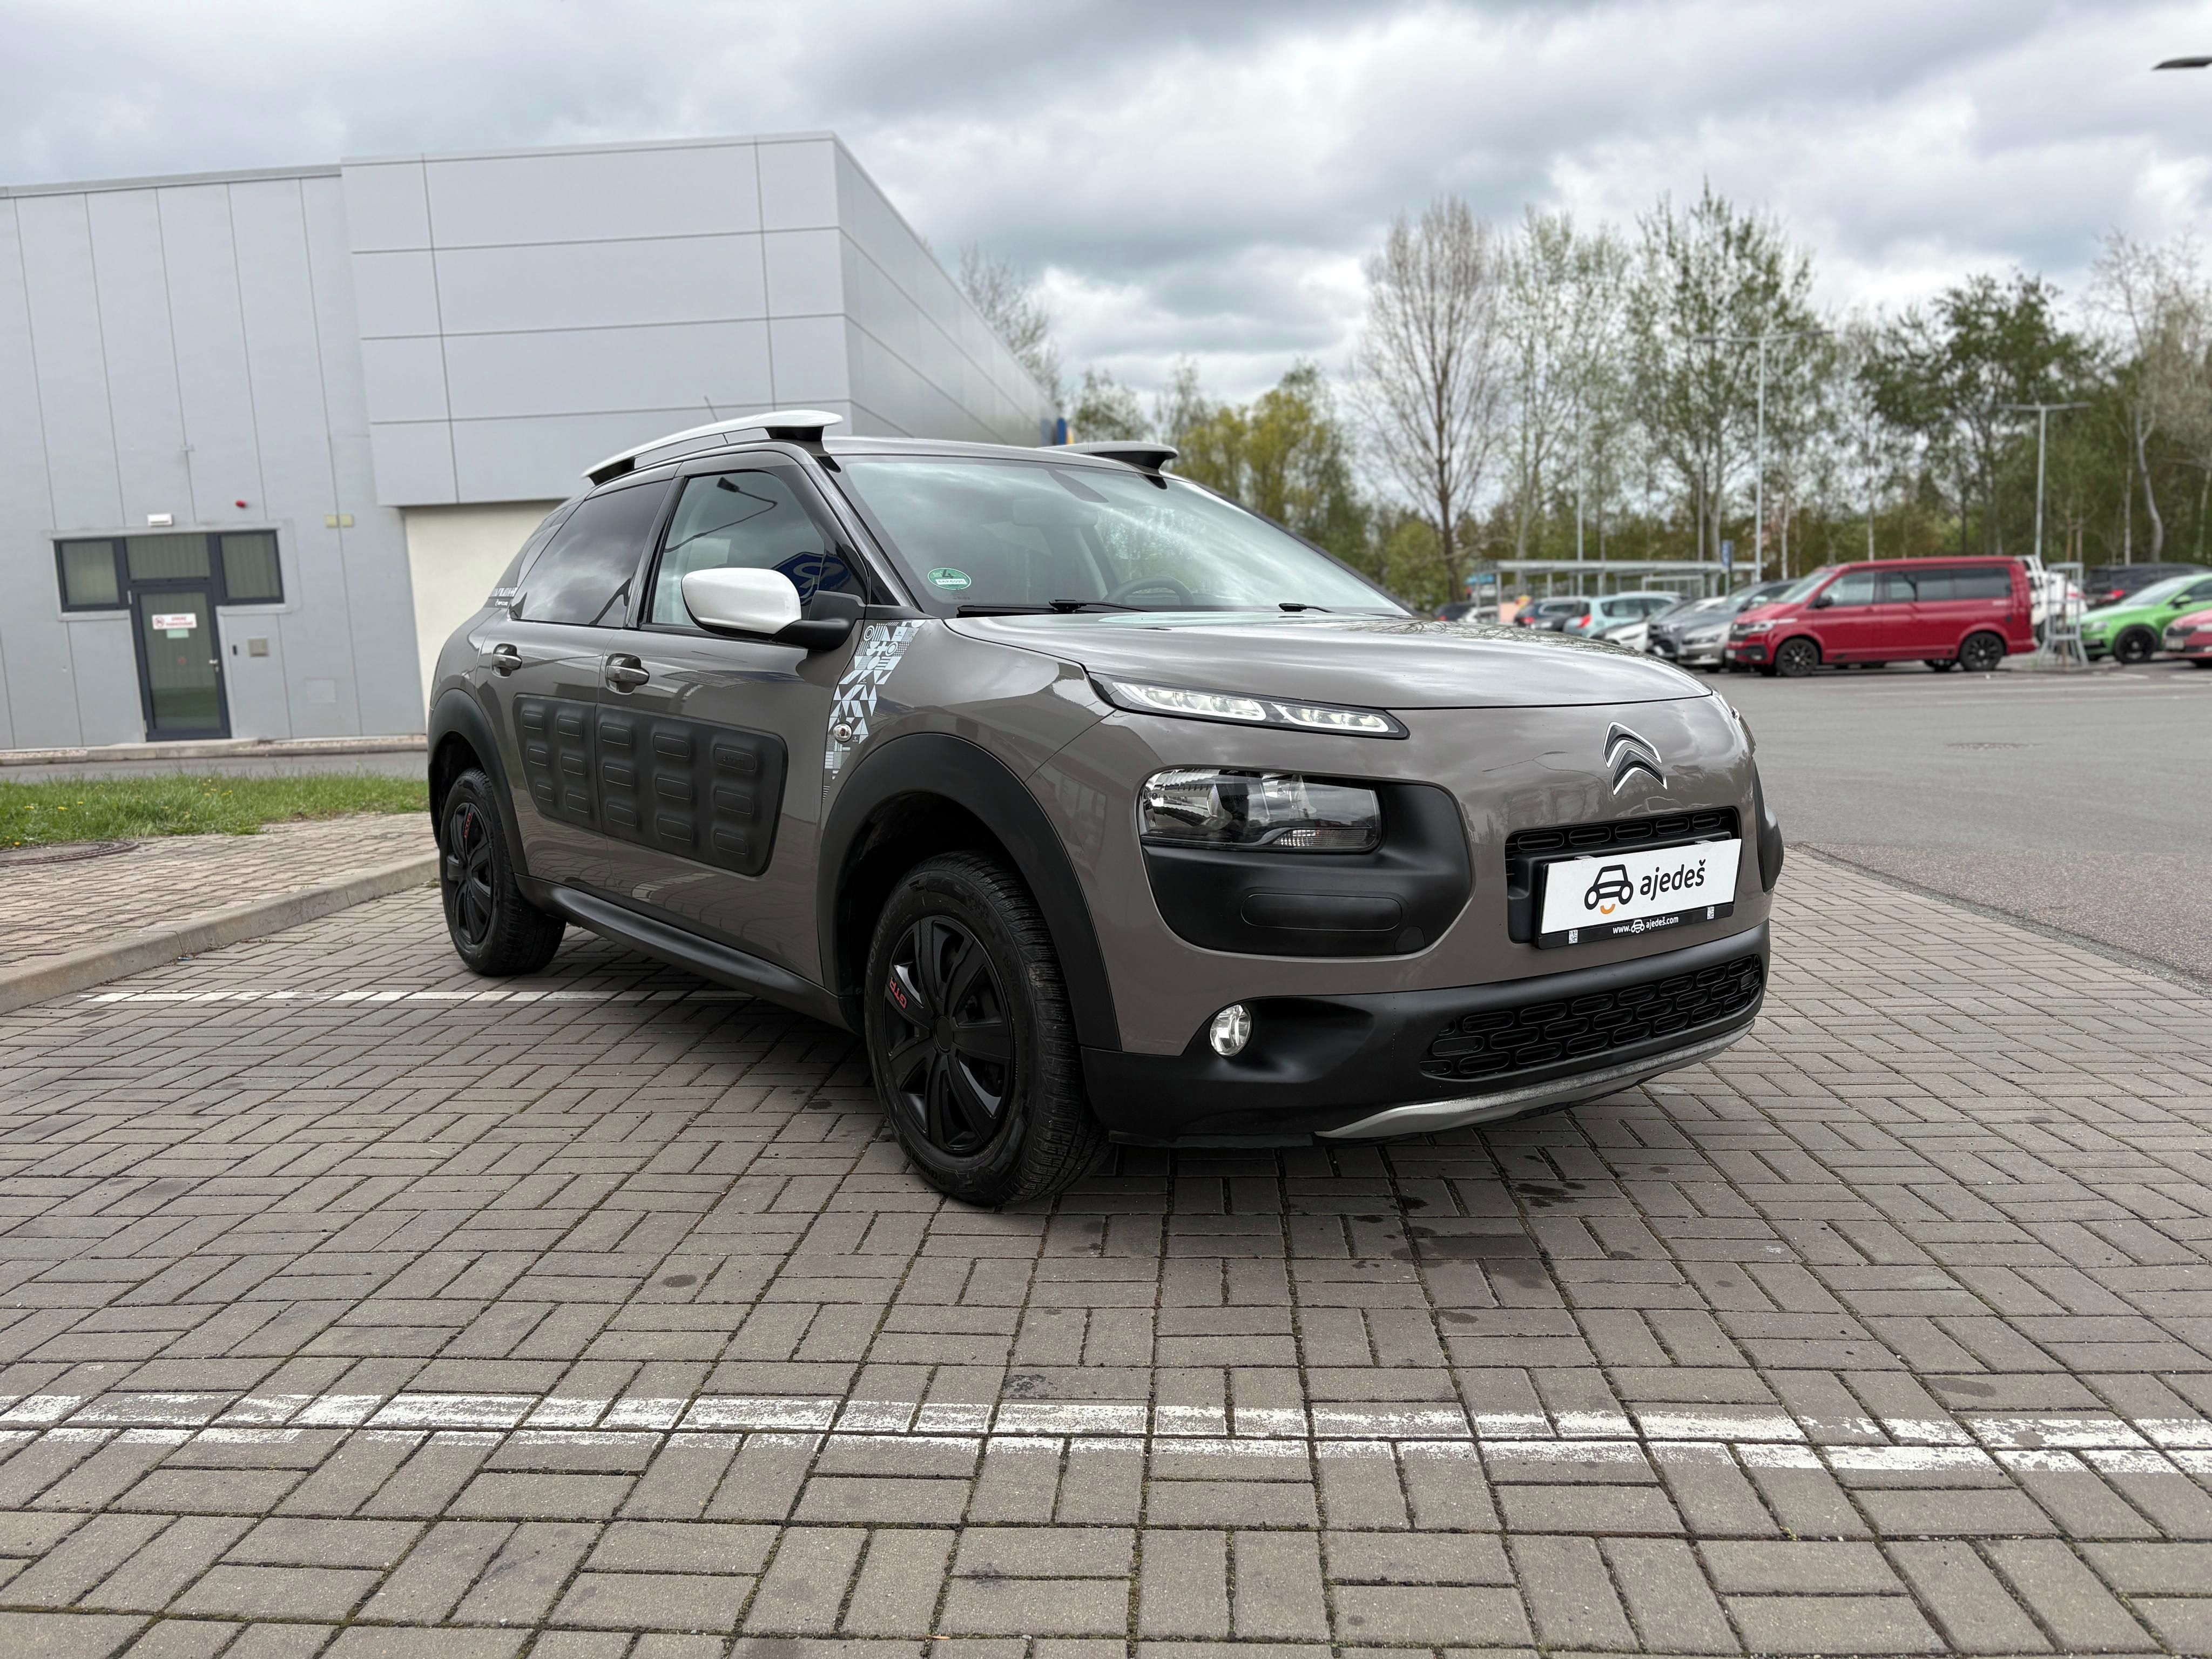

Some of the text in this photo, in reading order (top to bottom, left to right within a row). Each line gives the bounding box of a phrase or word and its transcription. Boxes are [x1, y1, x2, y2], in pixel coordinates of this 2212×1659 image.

[942, 569, 954, 578] 4
[1640, 859, 1706, 901] ajedeš
[1613, 916, 1679, 934] www. ajedeš.com
[890, 976, 907, 1009] GTR
